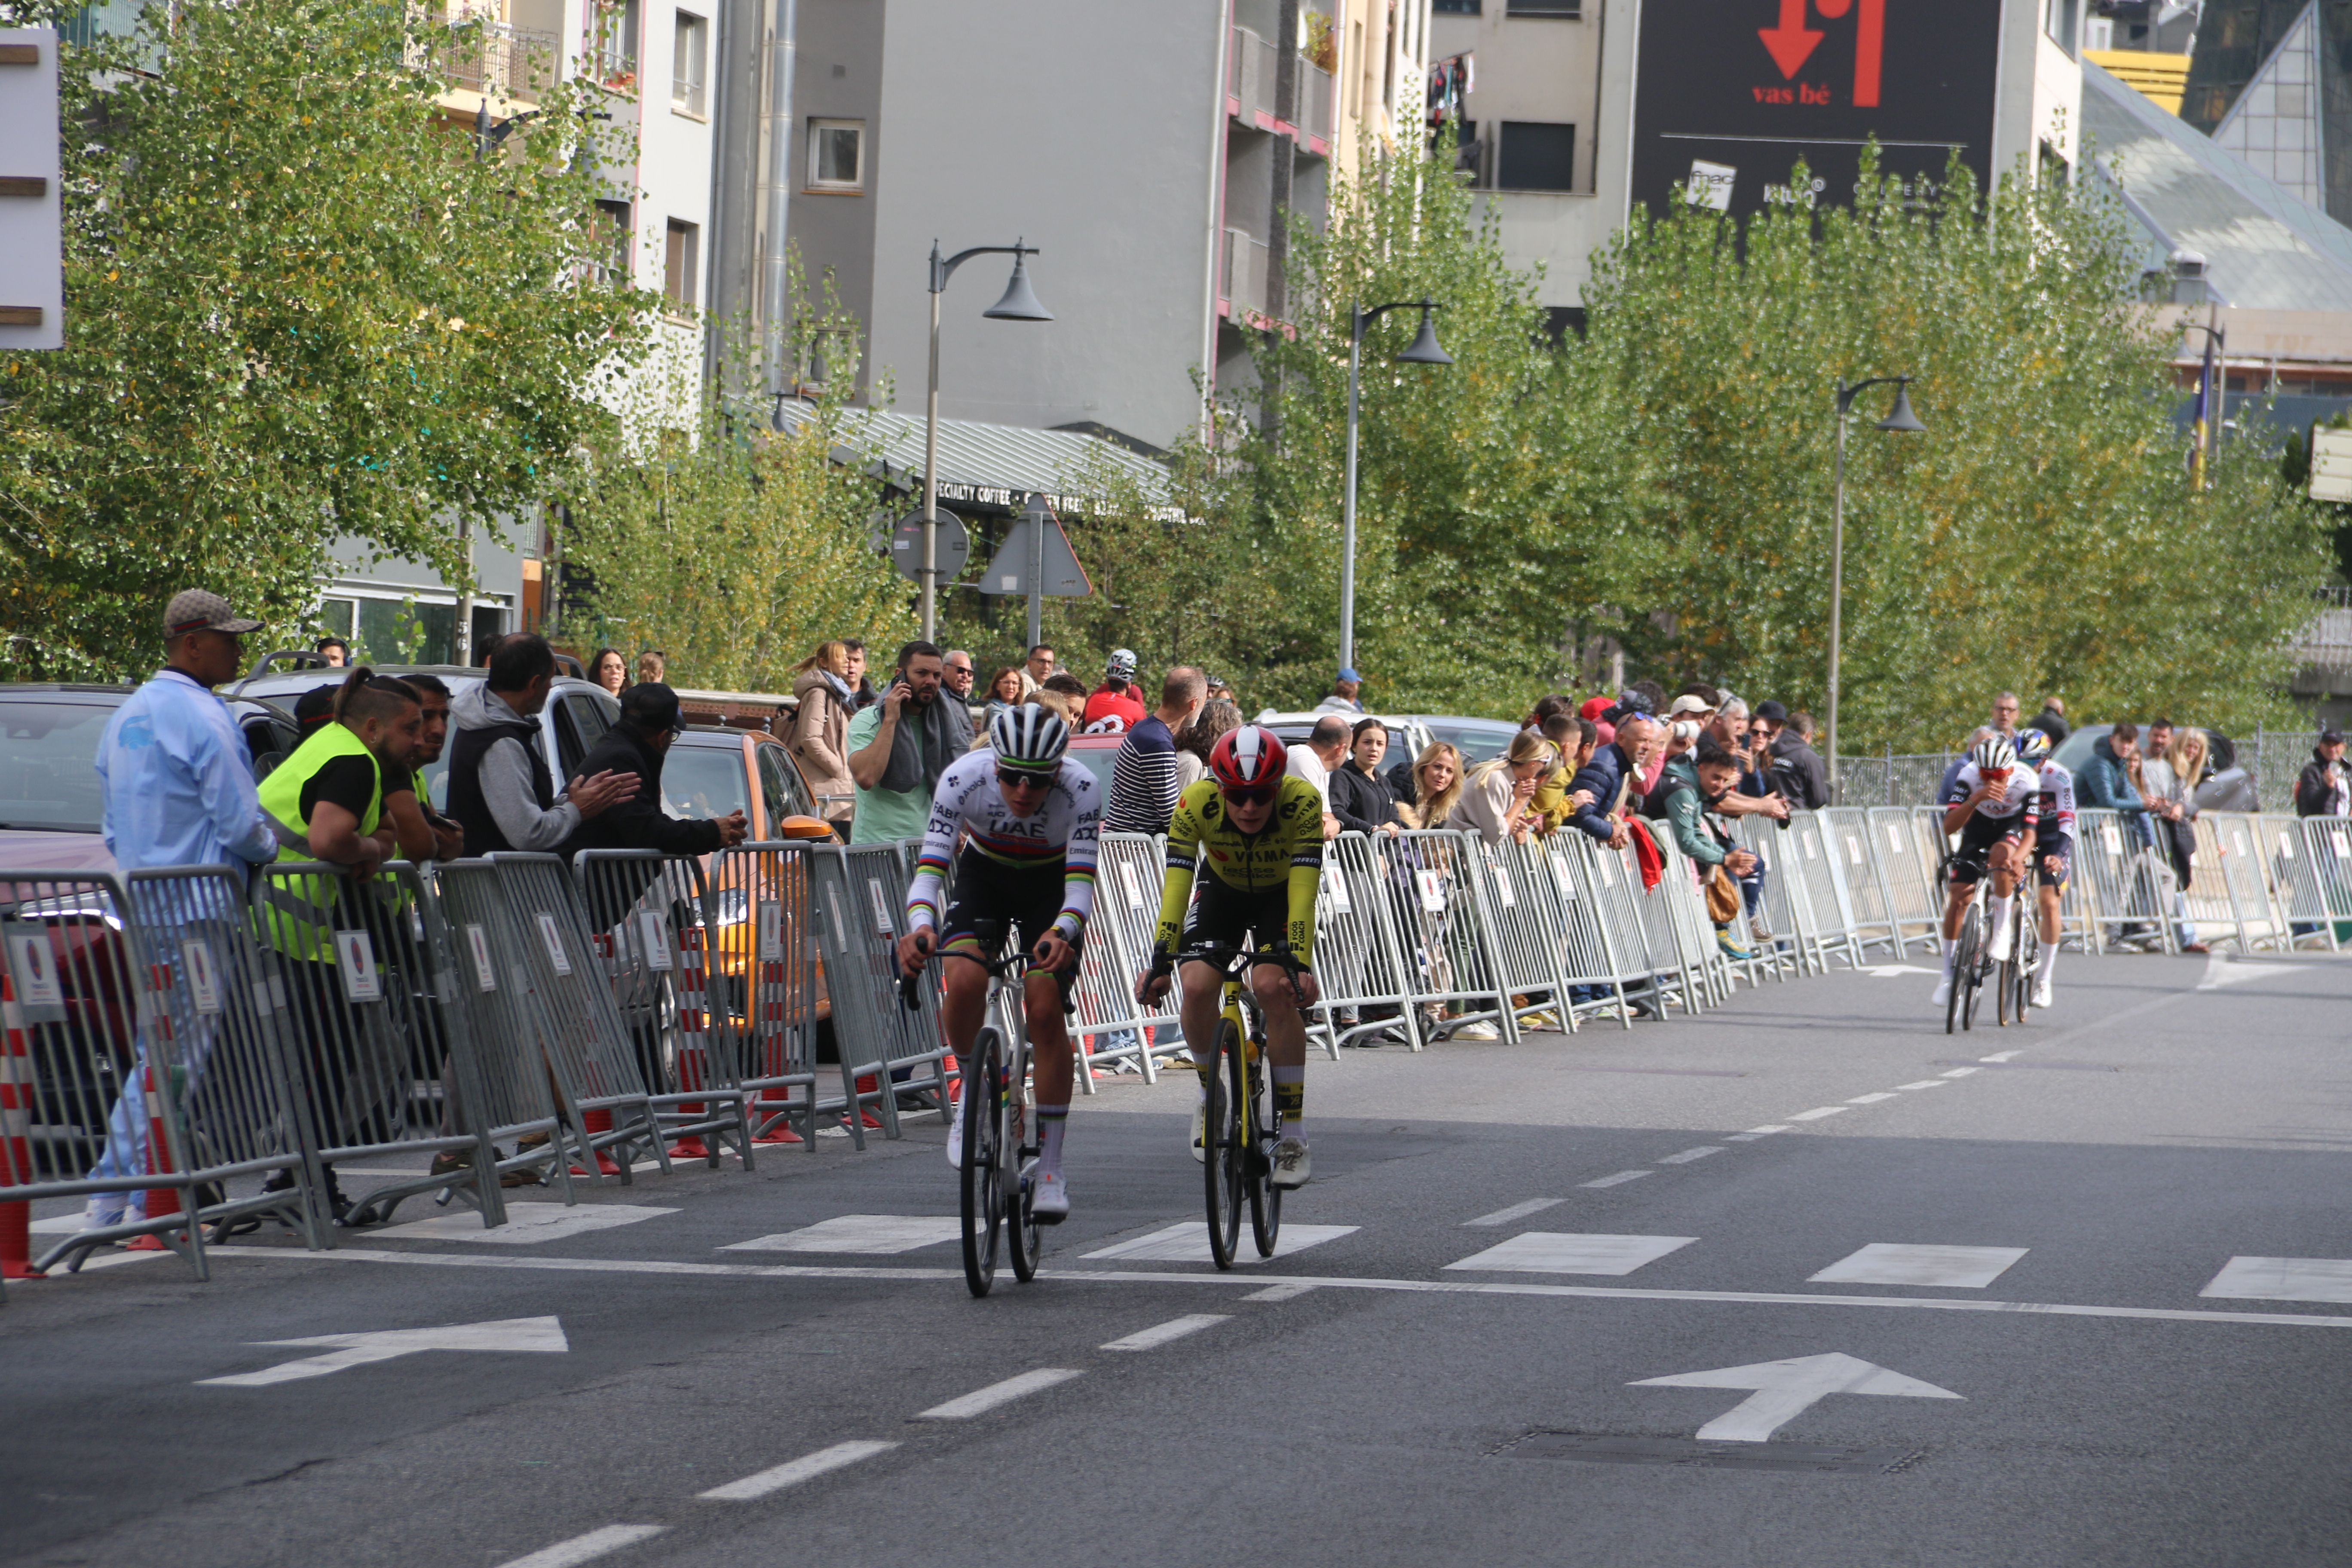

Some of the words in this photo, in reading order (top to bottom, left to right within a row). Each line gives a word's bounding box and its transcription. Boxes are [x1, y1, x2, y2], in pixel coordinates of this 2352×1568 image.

[1752, 87, 1794, 104] vas
[1800, 82, 1831, 105] bé
[936, 481, 975, 502] PECIALTY
[977, 486, 1011, 505] COFFEE
[2064, 787, 2072, 810] BOSS
[989, 820, 1047, 838] UAE
[1166, 858, 1195, 867] SRAM
[1235, 848, 1290, 863] VISMA
